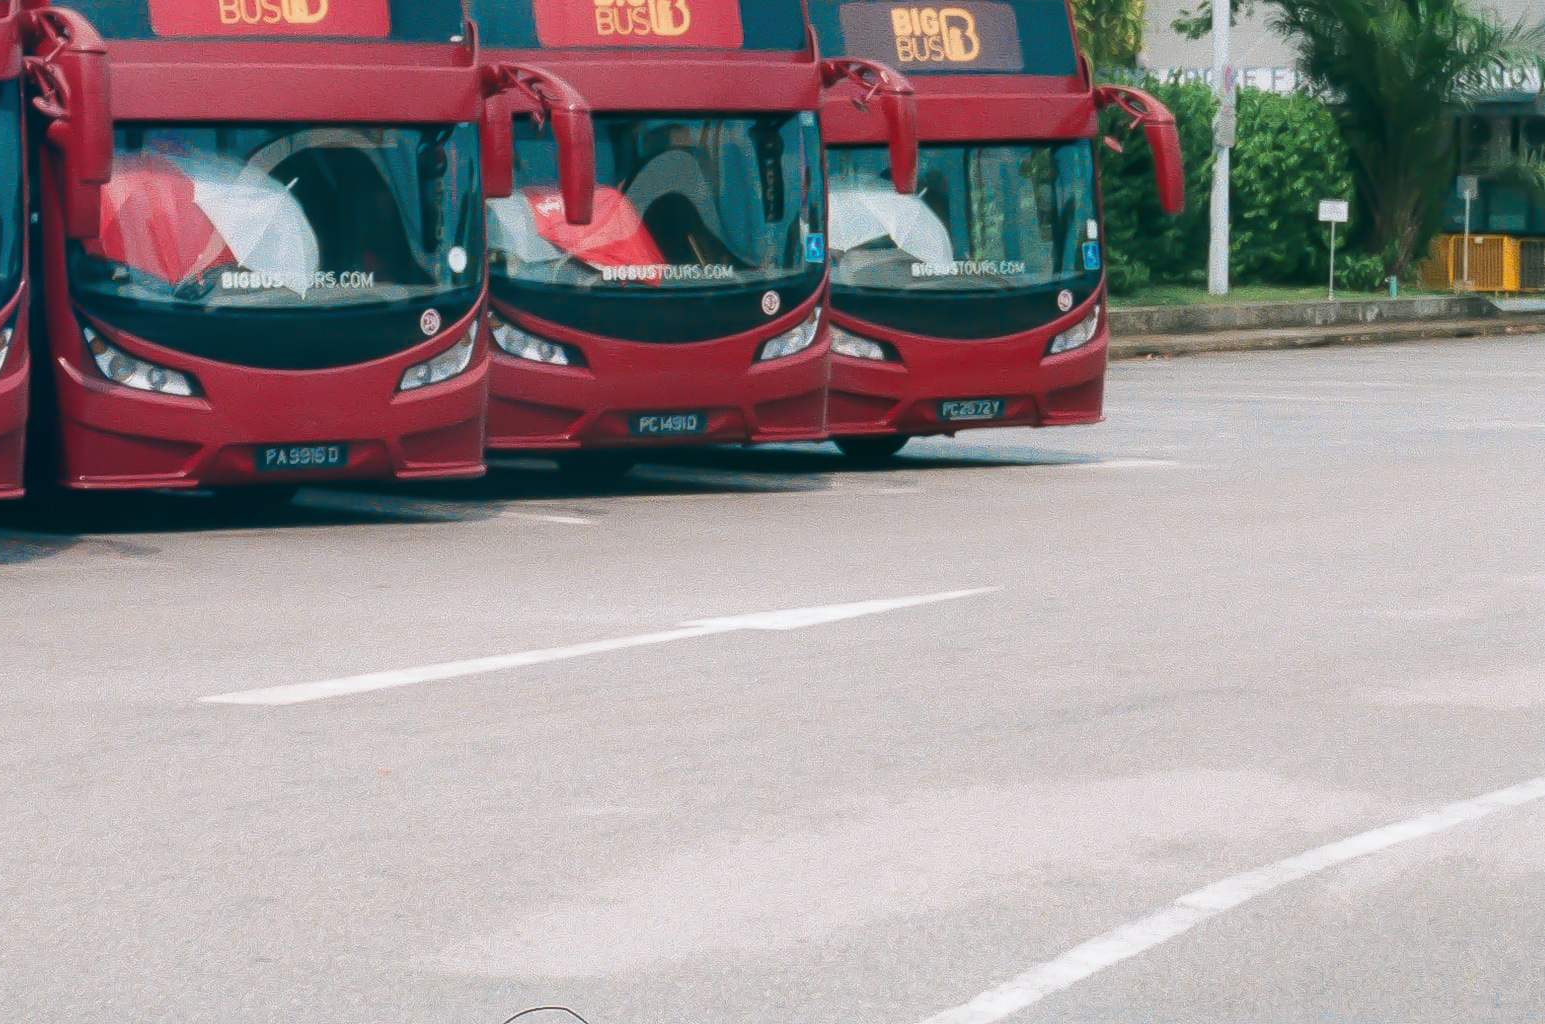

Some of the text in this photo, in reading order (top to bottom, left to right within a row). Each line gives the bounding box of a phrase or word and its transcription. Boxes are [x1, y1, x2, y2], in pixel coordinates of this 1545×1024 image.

[596, 6, 650, 35] BUS
[891, 7, 939, 36] BIG
[897, 35, 944, 62] BUS
[221, 270, 375, 289] BIGBUSRS.COM
[603, 264, 733, 280] BIGBUSTOURS.COM
